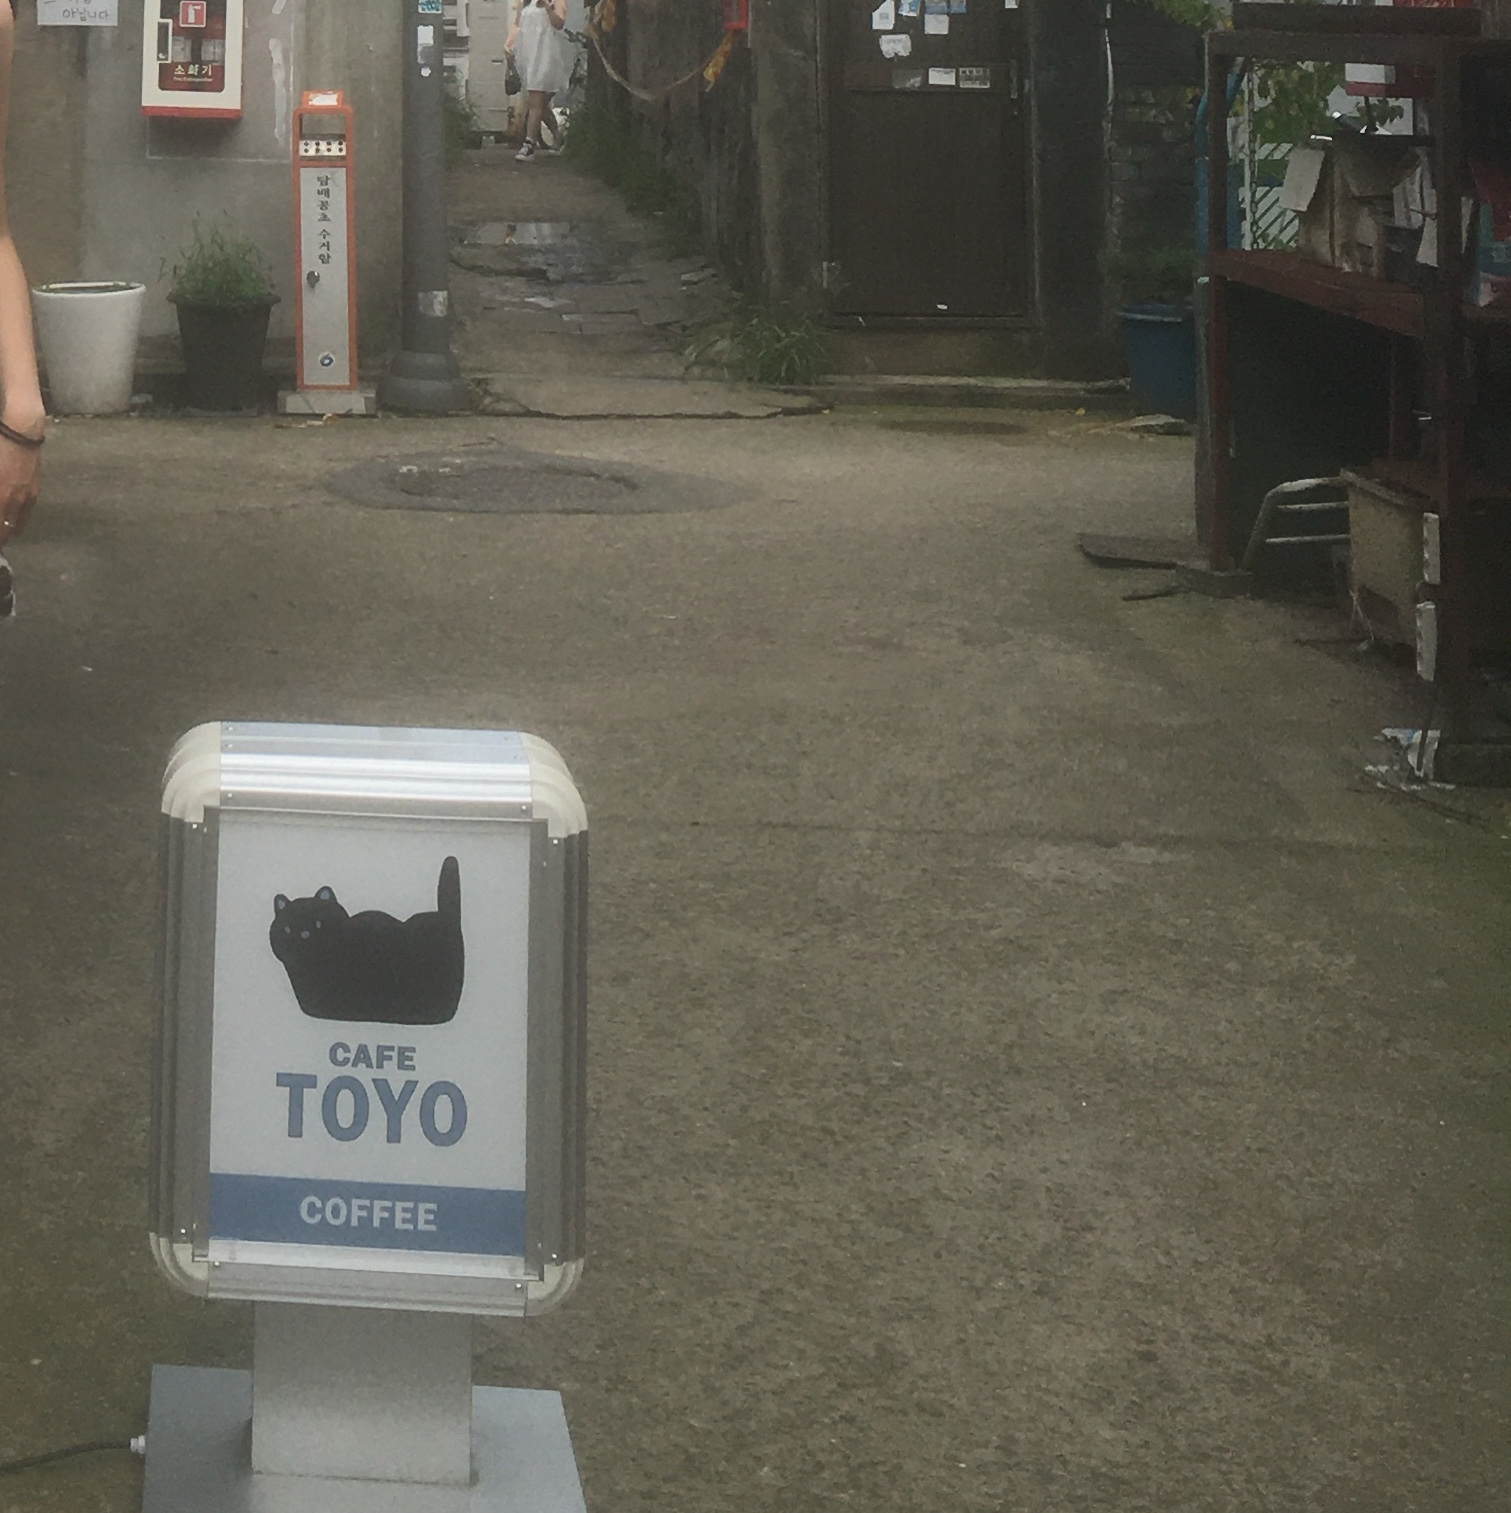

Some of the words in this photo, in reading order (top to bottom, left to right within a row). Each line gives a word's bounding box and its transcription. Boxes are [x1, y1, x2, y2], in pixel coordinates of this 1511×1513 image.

[62, 7, 111, 22] 아닙니다
[173, 64, 213, 76] 소화기
[328, 1041, 417, 1072] CAFE
[275, 1072, 469, 1148] TOYO
[299, 1195, 438, 1232] COFFEE
